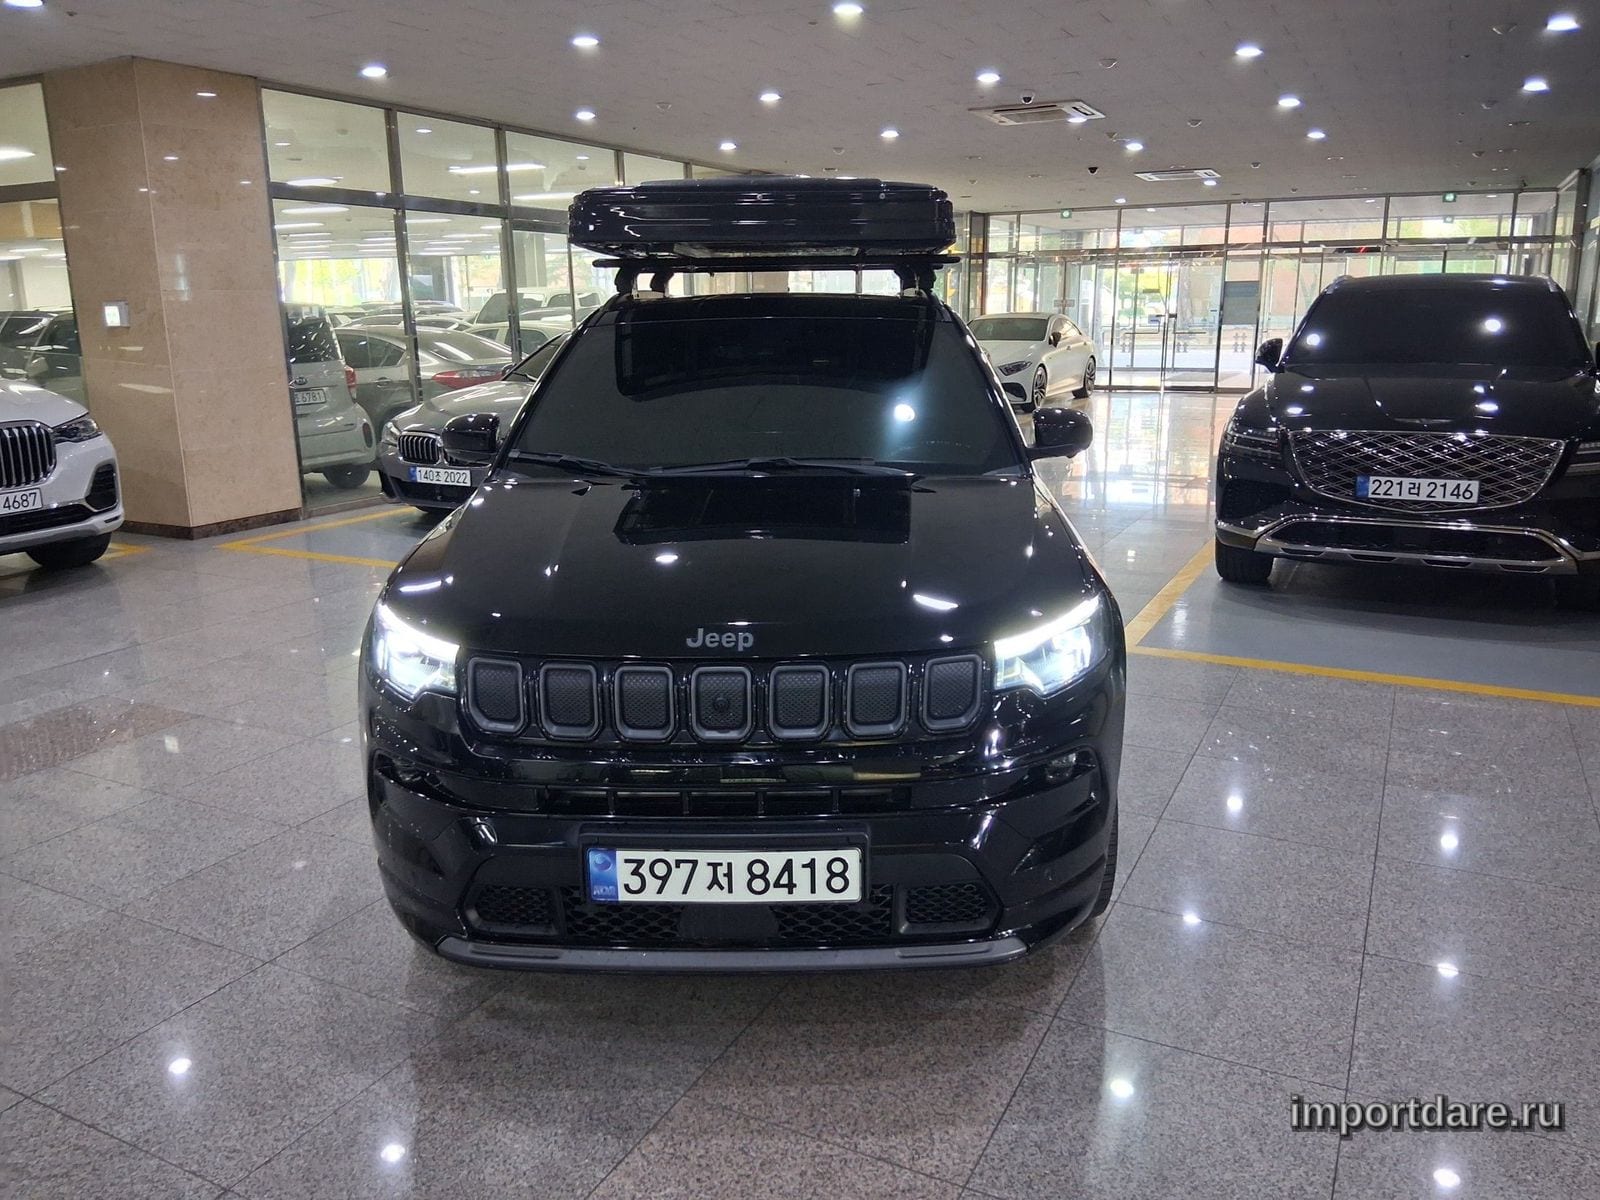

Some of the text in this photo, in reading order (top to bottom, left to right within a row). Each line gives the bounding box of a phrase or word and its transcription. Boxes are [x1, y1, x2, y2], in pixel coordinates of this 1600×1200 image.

[418, 469, 467, 484] 140조 2022
[1371, 479, 1473, 500] 221러 2146
[3, 492, 37, 510] 4687
[686, 628, 754, 651] Jeep
[623, 856, 850, 896] 397저 8418
